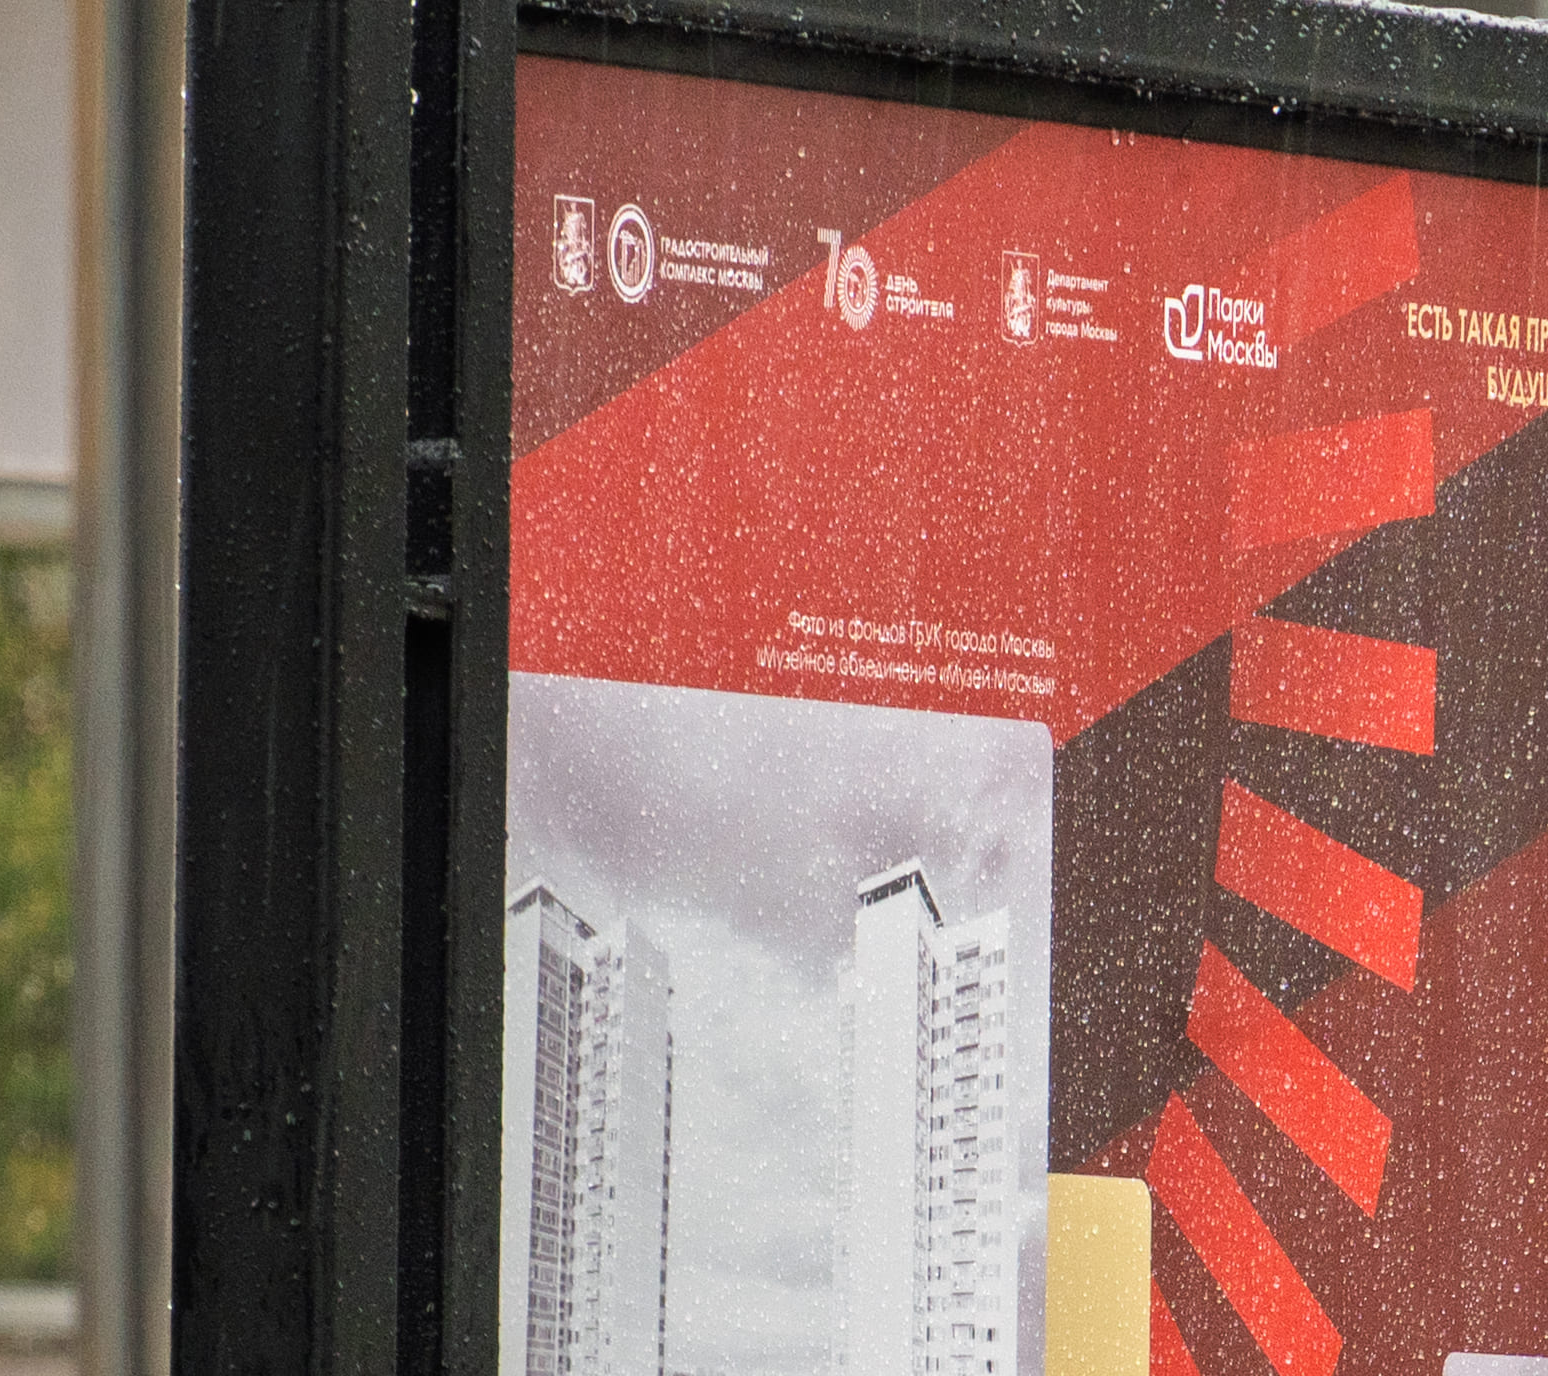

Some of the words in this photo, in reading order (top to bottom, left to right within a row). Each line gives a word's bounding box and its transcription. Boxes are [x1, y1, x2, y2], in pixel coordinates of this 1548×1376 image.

[661, 237, 768, 266] ГРАДОСТРОИТЕЛЬНЫЙ
[660, 261, 716, 285] КОМПЛЕКС
[718, 271, 763, 290] МОСКВЫ
[885, 274, 918, 293] ДЕНЬ
[1047, 269, 1108, 292] Департамент
[886, 294, 953, 319] СТРОИТЕЛЯ
[1046, 298, 1090, 316] культуры
[1208, 288, 1264, 337] Парки
[1046, 321, 1078, 338] города
[1081, 322, 1118, 341] Москвы
[1408, 302, 1452, 340] ЕСТЬ
[1459, 309, 1520, 349] ТАКАЯ
[1208, 330, 1278, 368] Москвы
[788, 610, 824, 635] Фото
[830, 618, 844, 637] из
[848, 619, 905, 644] фондов
[909, 621, 941, 648] ГБУК
[946, 629, 996, 654] города
[1000, 632, 1055, 658] Москвы
[839, 651, 936, 683] объединение
[940, 660, 992, 692] «Музей
